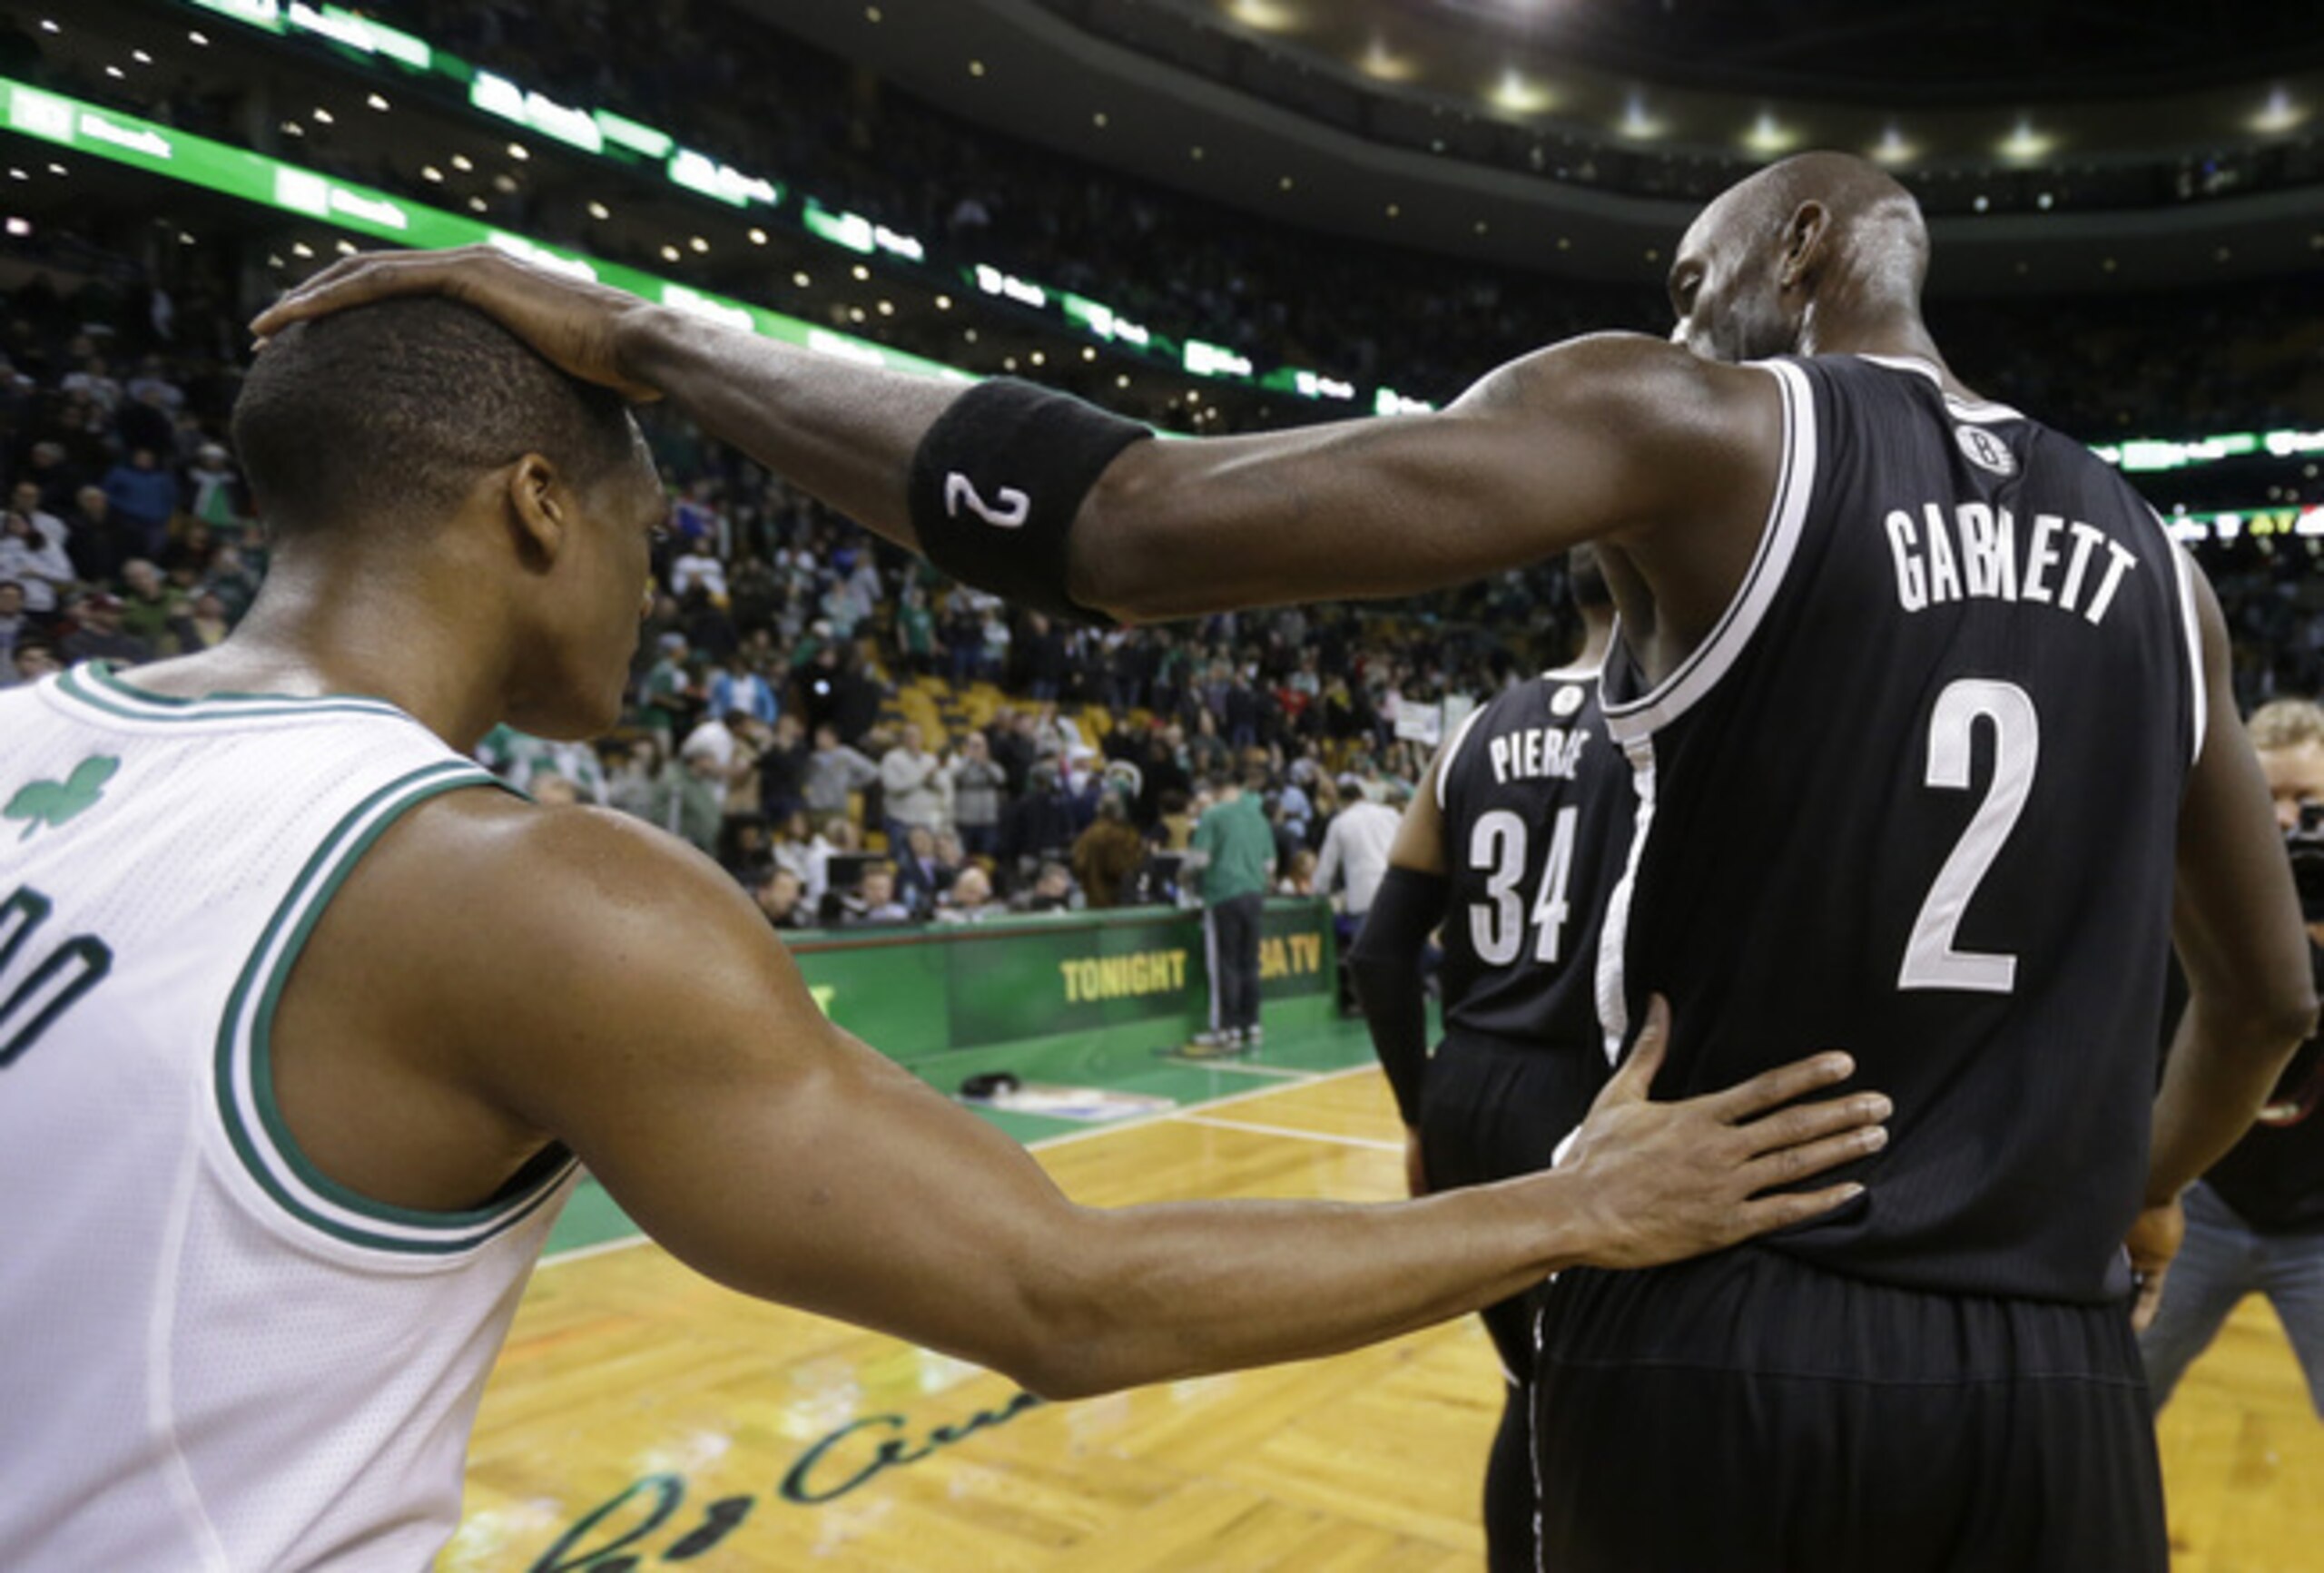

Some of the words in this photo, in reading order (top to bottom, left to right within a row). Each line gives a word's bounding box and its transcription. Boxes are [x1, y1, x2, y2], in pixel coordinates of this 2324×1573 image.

[945, 470, 1031, 529] 2
[1468, 805, 1579, 967] 34
[1897, 678, 2040, 992] 2
[1059, 949, 1187, 1003] TONIGHT
[1288, 933, 1321, 974] TV
